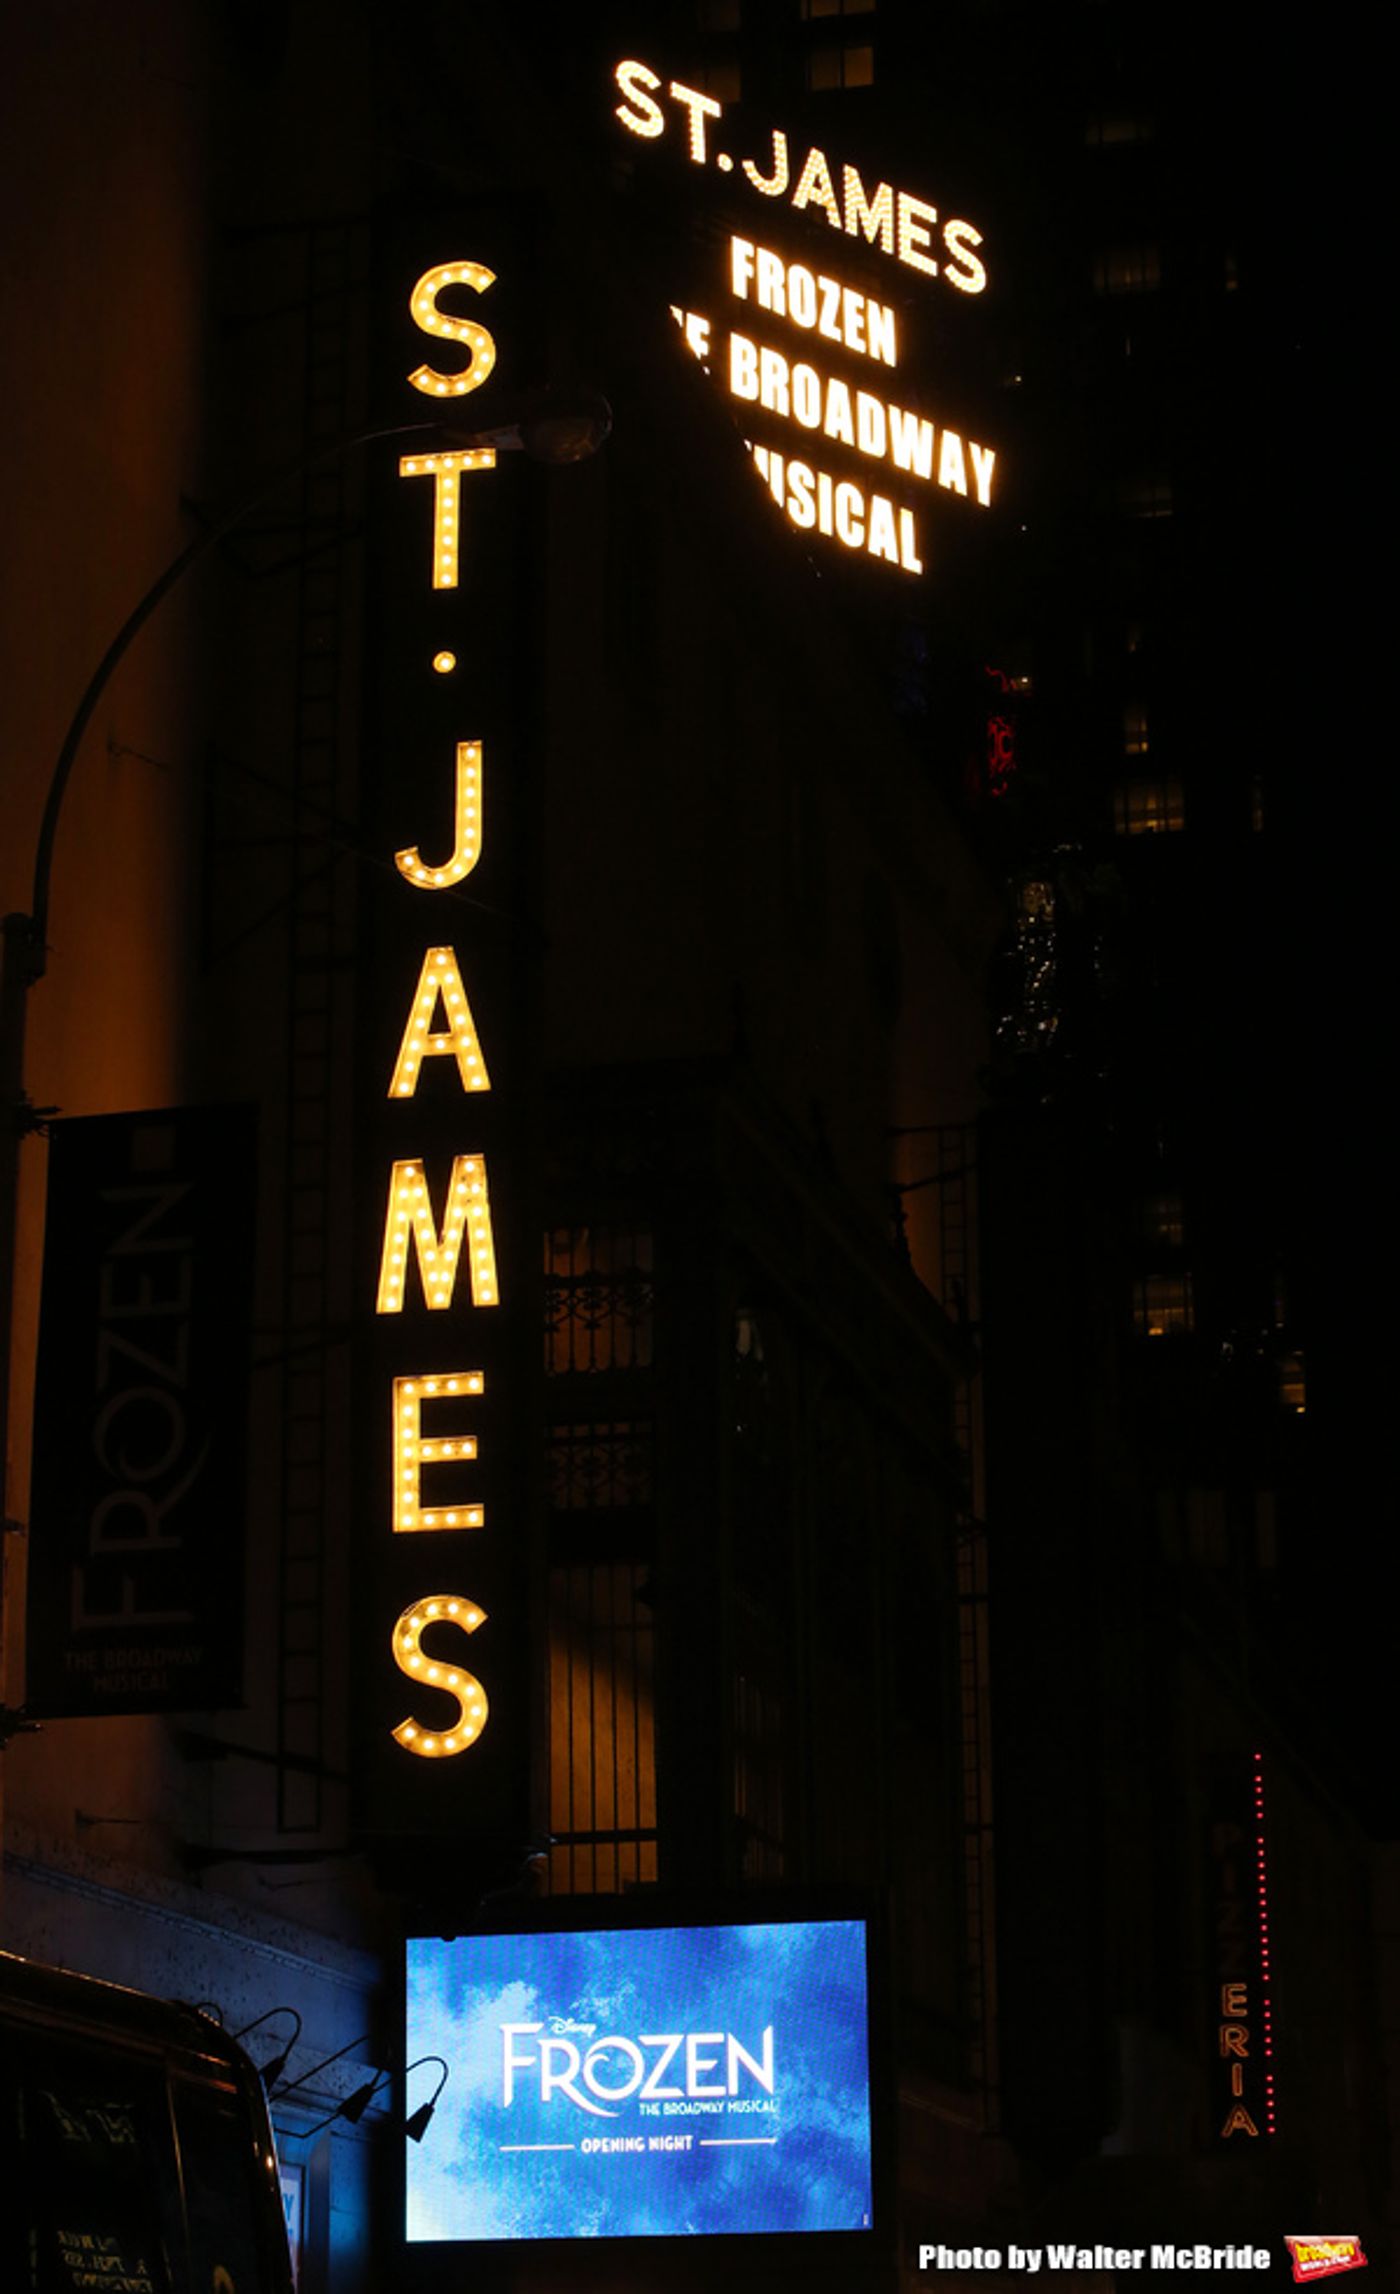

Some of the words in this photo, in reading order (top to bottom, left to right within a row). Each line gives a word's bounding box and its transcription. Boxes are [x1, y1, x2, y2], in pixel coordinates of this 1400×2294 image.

[614, 60, 734, 172] ST.
[741, 130, 987, 294] JAMES
[730, 235, 898, 368] FROZEN
[729, 331, 996, 508] BROADWAY
[744, 440, 923, 575] USICAL
[376, 740, 499, 1757] JAMES
[68, 1180, 212, 1634] FROZEN
[64, 1650, 96, 1671] THE
[103, 1645, 201, 1669] BROADWAY
[94, 1671, 168, 1693] MUSICAL
[499, 2024, 774, 2117] FROZEN
[548, 2015, 597, 2036] Disney
[581, 2137, 645, 2154] OPENING
[649, 2135, 693, 2151] NIGHT
[639, 2102, 660, 2116] THE
[663, 2101, 724, 2116] BROADWAY
[727, 2099, 777, 2113] MUSICAL
